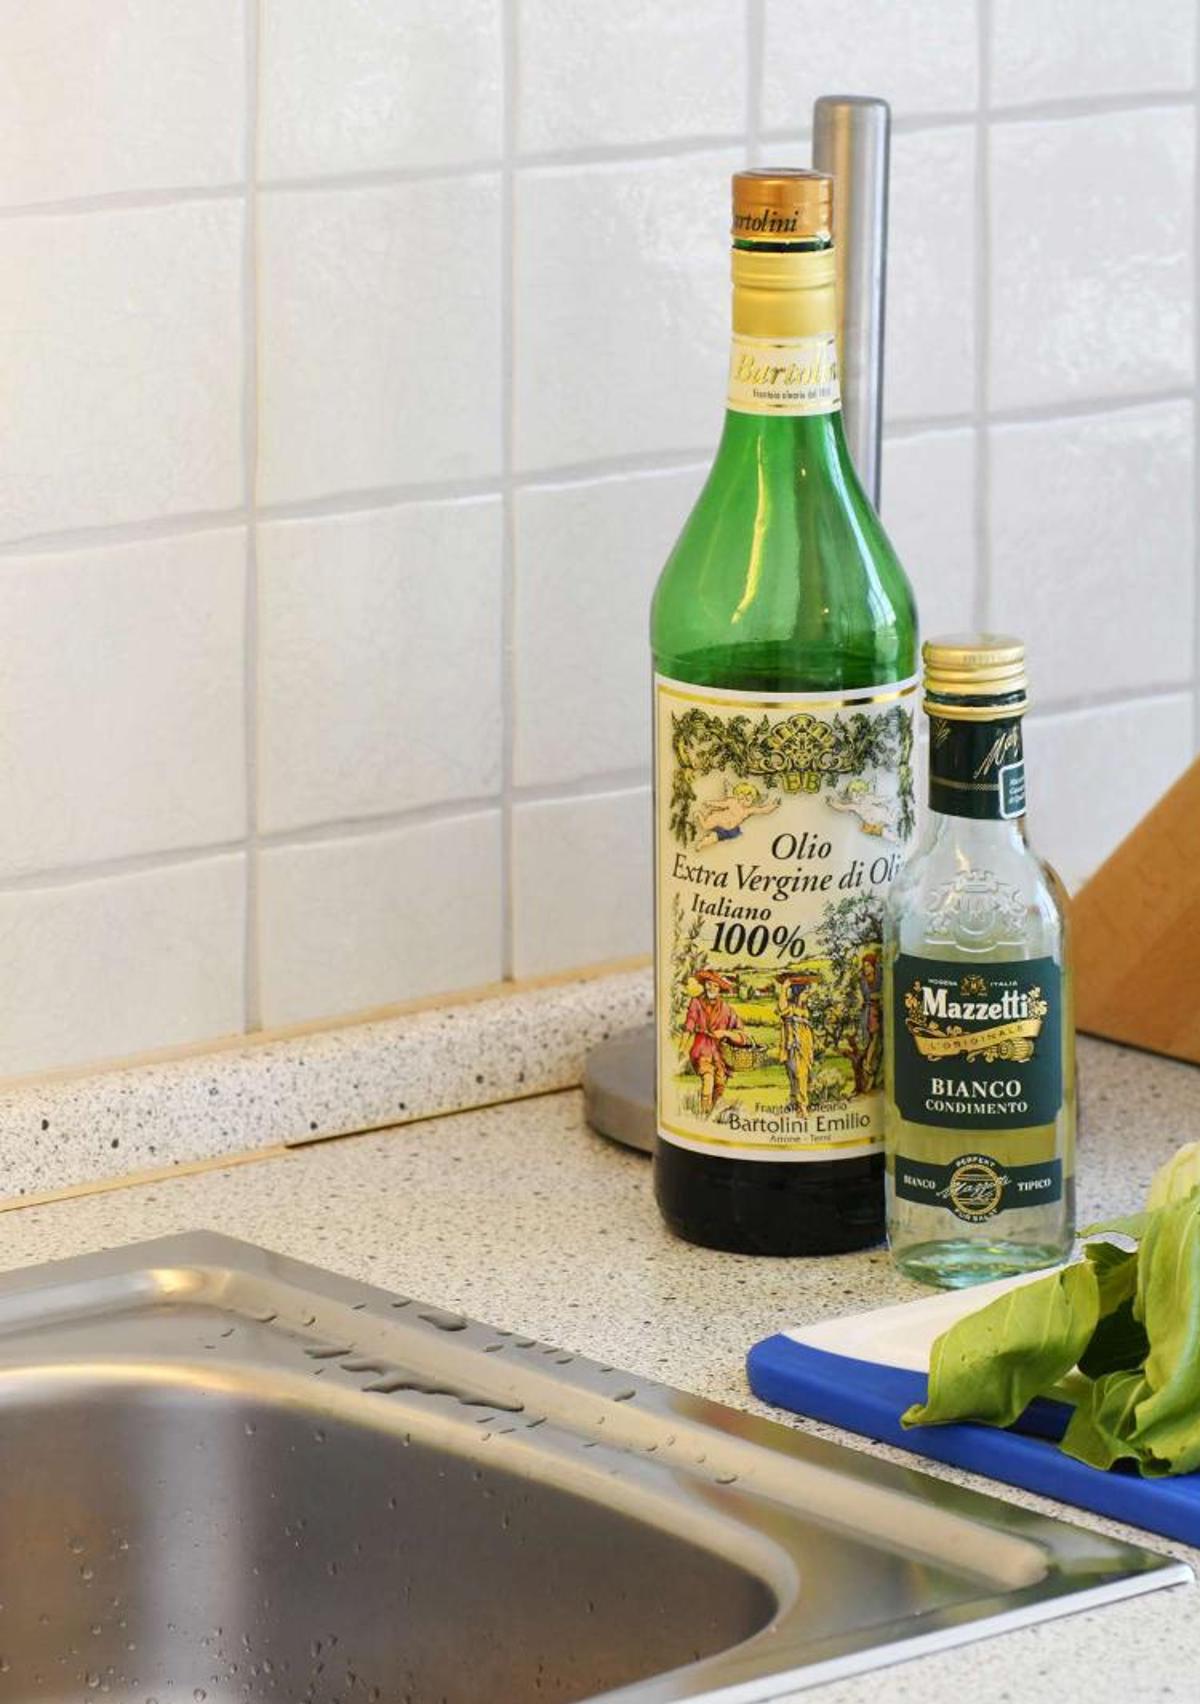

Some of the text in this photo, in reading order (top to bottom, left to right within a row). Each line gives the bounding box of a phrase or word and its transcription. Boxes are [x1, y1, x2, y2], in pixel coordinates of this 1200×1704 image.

[771, 832, 832, 861] Olio
[671, 853, 729, 889] Extra
[735, 863, 833, 902] Vergine
[839, 860, 864, 890] di
[690, 893, 772, 921] Italiano
[709, 922, 806, 959] 100%
[930, 1077, 1022, 1099] BIANCO
[925, 1098, 1028, 1115] CONDIMENTO
[729, 1112, 871, 1133] Bartolini Emilio
[903, 1173, 936, 1190] BIANCO
[1016, 1178, 1052, 1192] TIPICO
